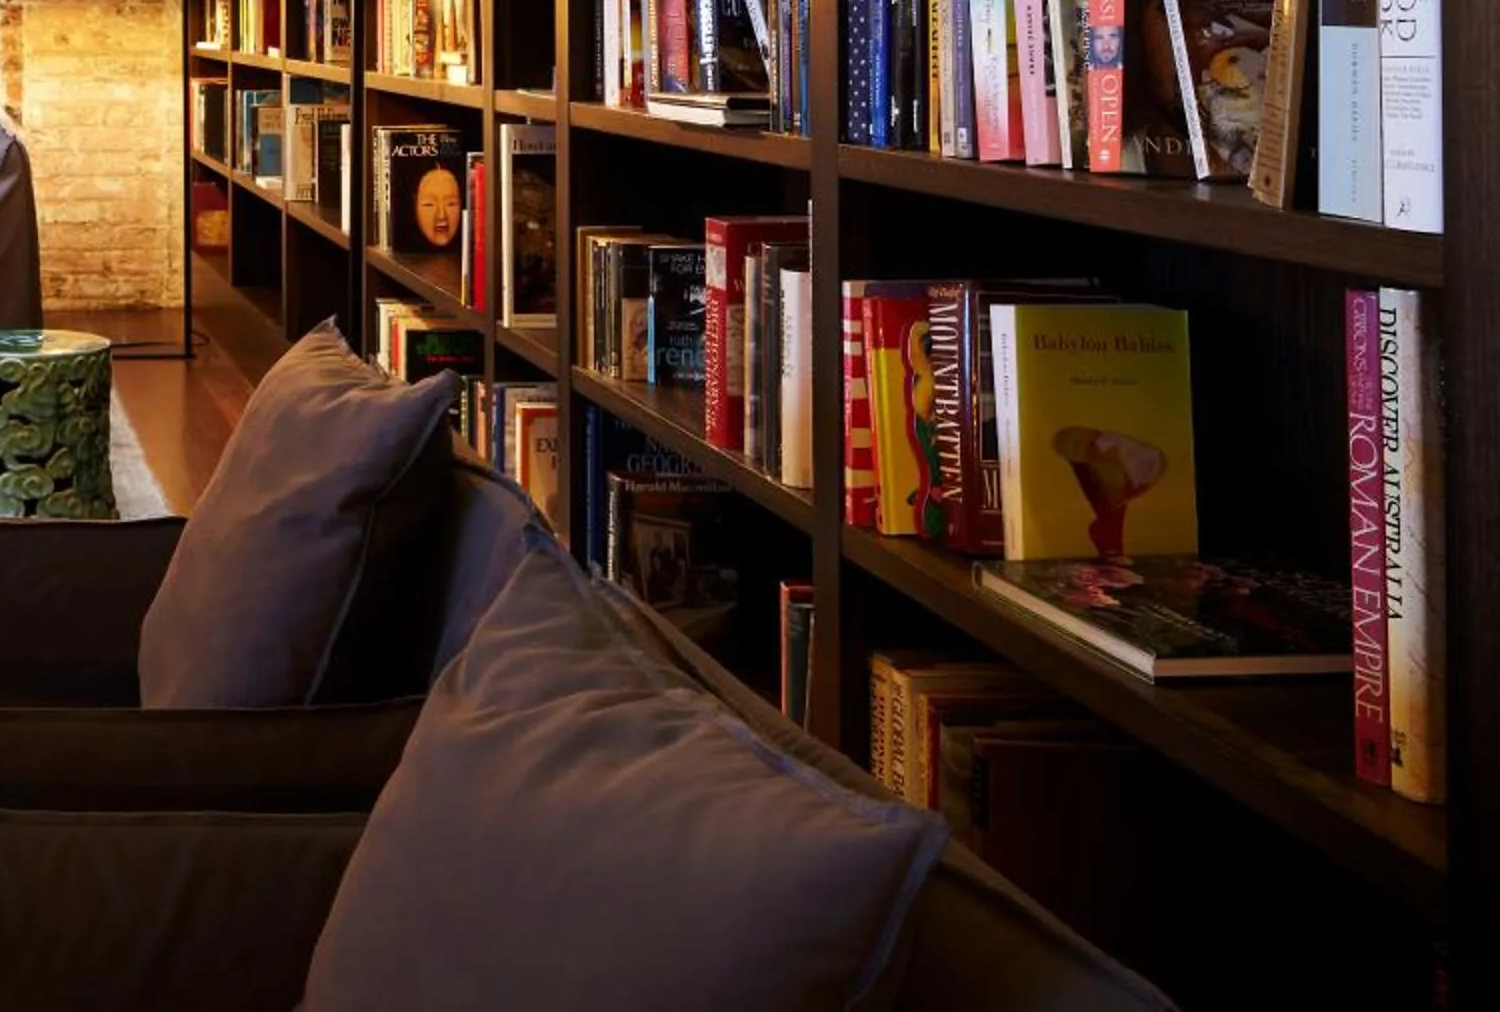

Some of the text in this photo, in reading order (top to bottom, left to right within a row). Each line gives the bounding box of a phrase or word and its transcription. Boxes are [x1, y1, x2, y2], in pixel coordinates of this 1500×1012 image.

[416, 133, 437, 145] THE
[1100, 75, 1118, 143] OPEN
[391, 145, 439, 157] ACTORS
[1033, 334, 1175, 354] Babylon Babies
[929, 303, 963, 503] MOUNTBATTEN
[1380, 307, 1404, 620] DISCOVER AUSTRALIA
[1349, 411, 1384, 723] ROMAN EMPIRE
